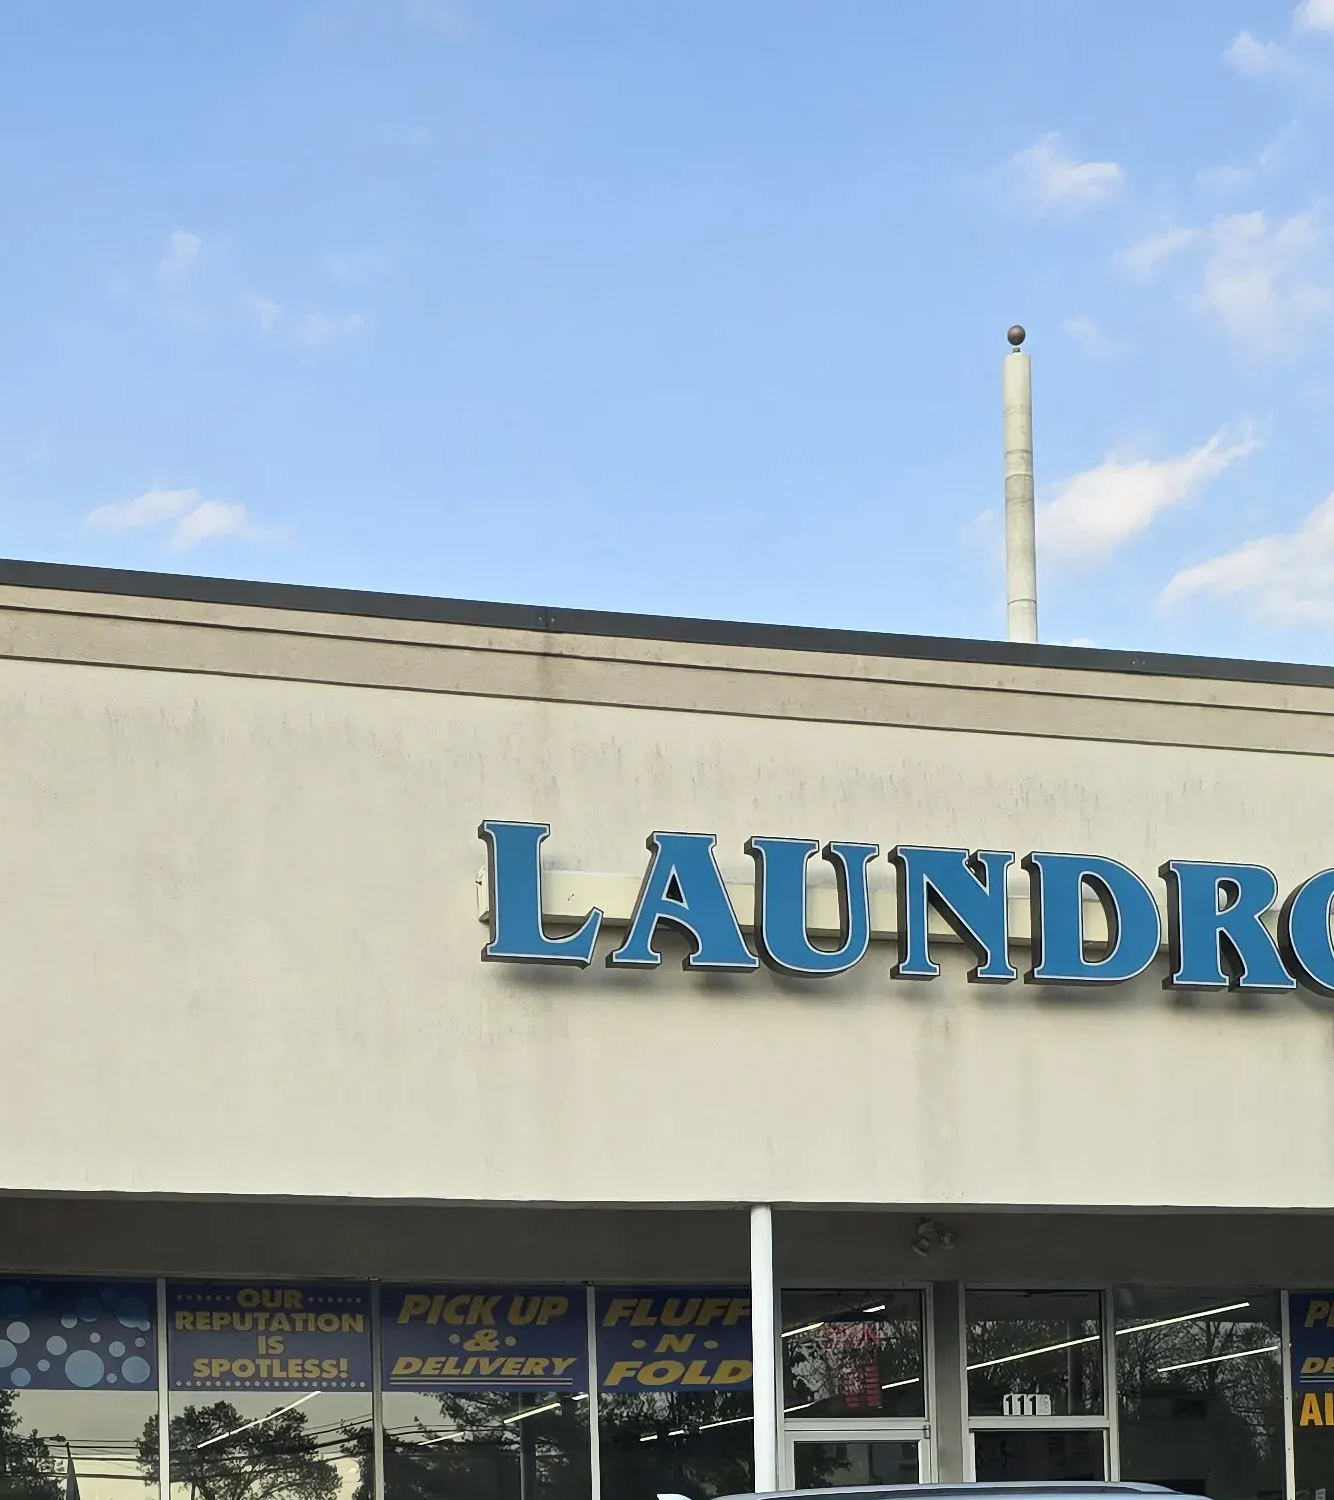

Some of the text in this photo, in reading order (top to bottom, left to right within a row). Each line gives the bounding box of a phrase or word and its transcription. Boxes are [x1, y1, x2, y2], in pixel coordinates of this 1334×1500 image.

[236, 1288, 303, 1309] OUR
[397, 1293, 568, 1326] PICK UP
[175, 1310, 364, 1333] REPUTATION
[602, 1298, 752, 1327] FLUFF
[257, 1335, 285, 1355] IS
[192, 1357, 349, 1379] SPOTLESS!
[390, 1356, 577, 1376] DELIVERY
[603, 1359, 753, 1387] FOLD
